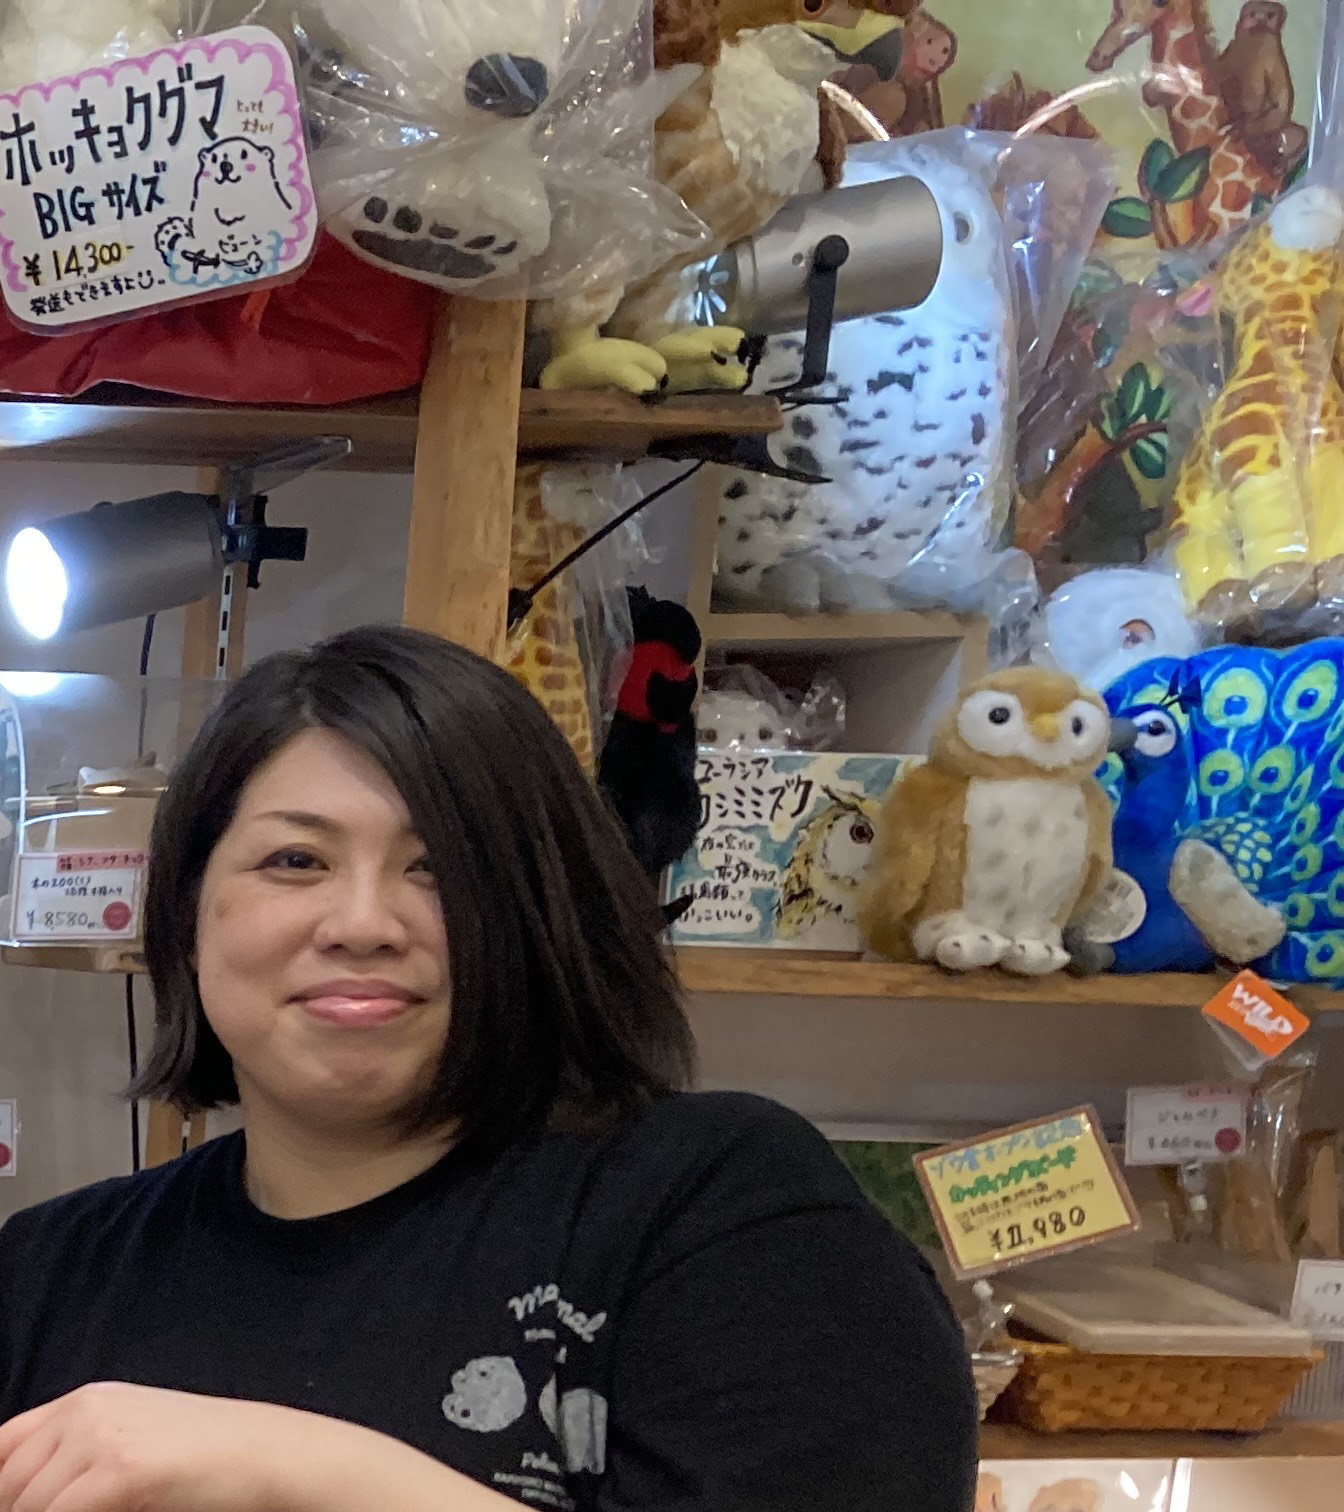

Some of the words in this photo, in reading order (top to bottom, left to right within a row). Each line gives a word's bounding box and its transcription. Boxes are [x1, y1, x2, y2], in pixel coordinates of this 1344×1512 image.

[0, 63, 225, 186] ホッキョクグマ
[33, 186, 96, 239] BIG
[102, 161, 167, 220] サイズ
[1232, 983, 1293, 1035] WILD
